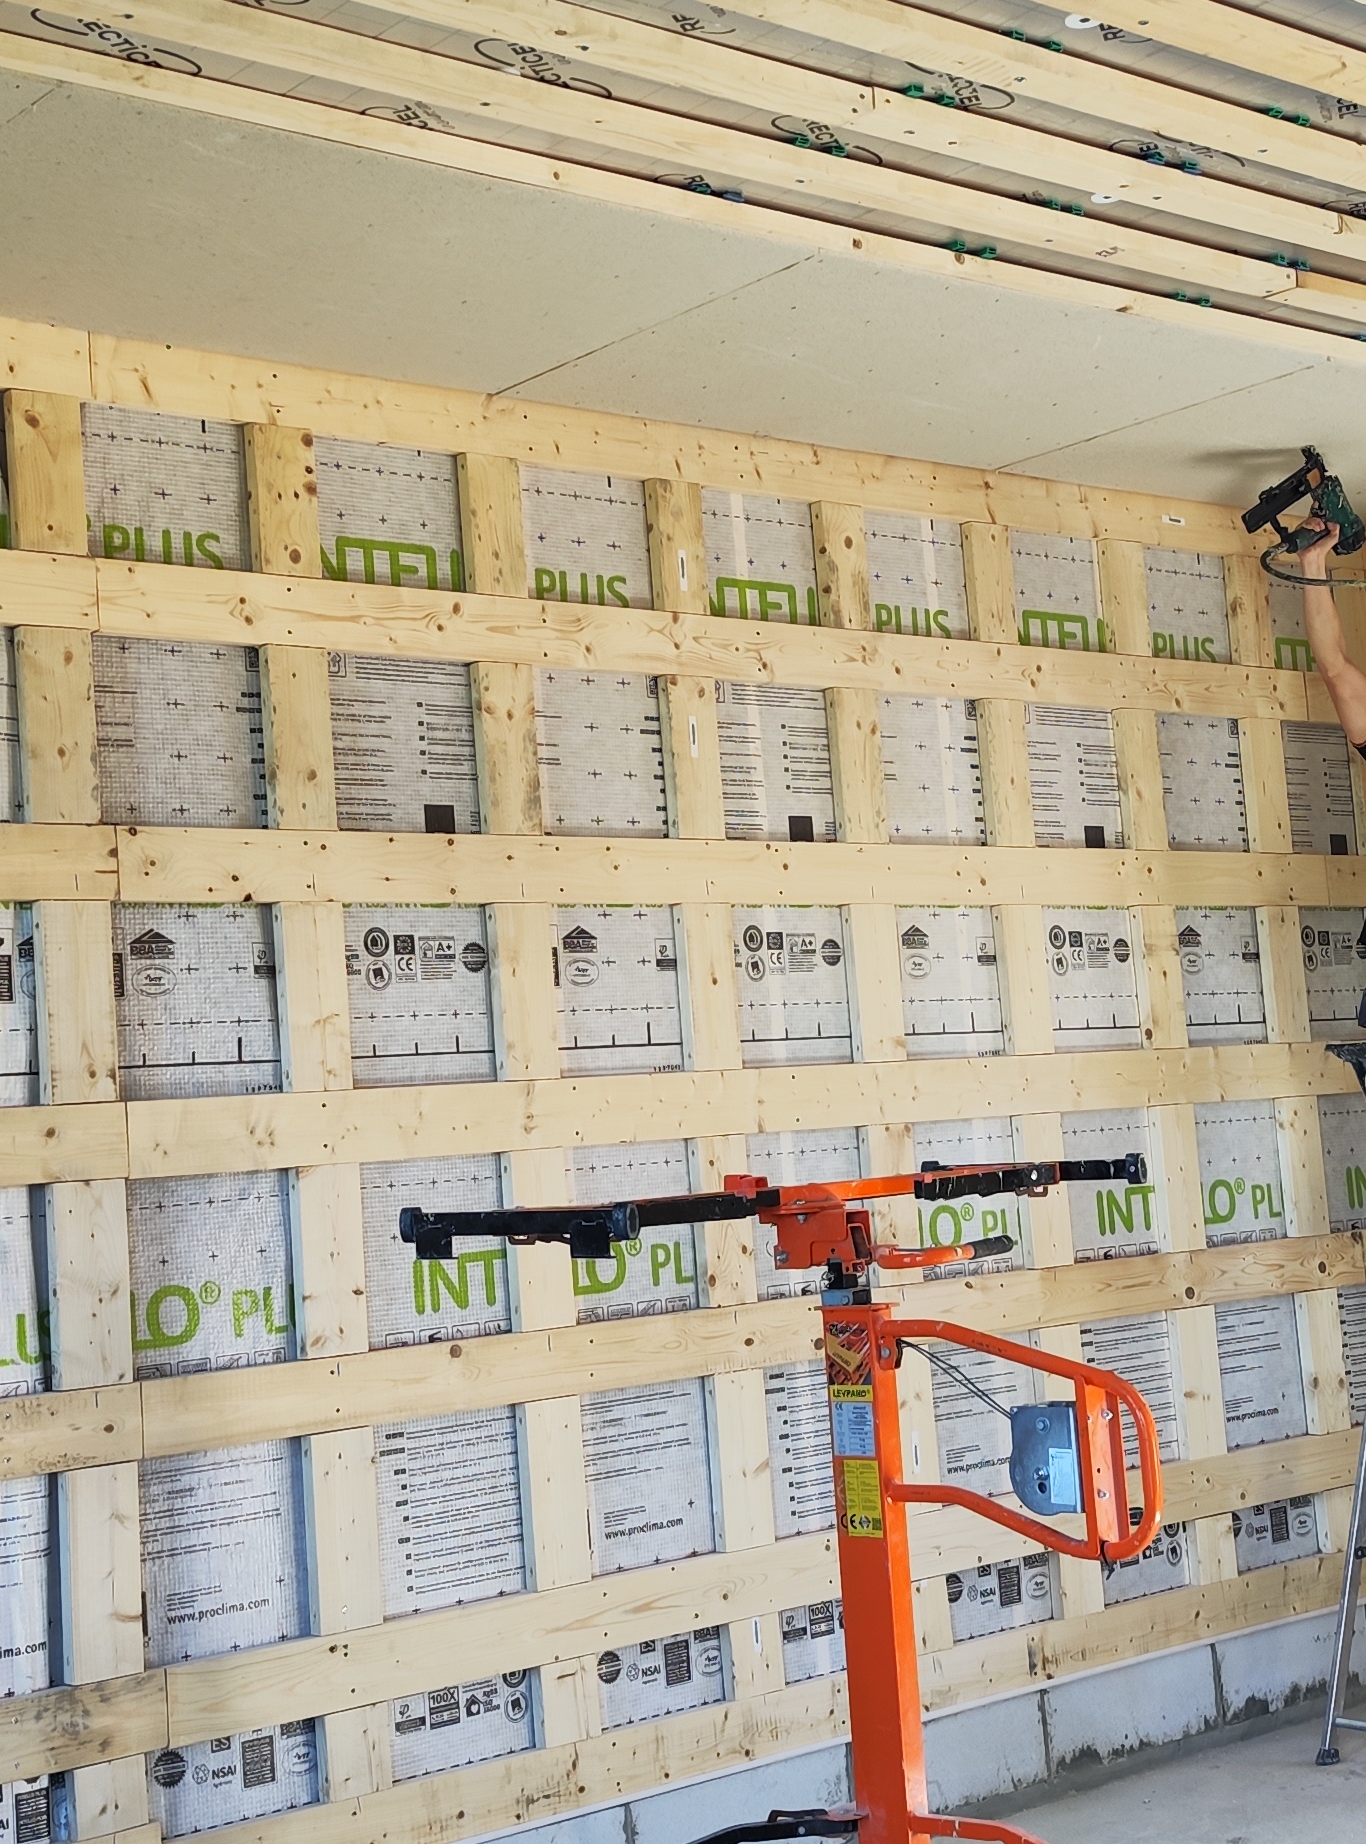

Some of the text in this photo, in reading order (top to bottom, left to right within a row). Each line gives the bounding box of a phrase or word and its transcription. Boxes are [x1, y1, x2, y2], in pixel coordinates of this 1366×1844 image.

[535, 567, 628, 608] PLUS
[875, 603, 951, 640] PLUS
[1151, 631, 1217, 663] PLUS
[436, 942, 453, 953] A+
[397, 956, 414, 971] CE
[769, 952, 783, 965] CE
[604, 1518, 684, 1541] www.proclima.com
[166, 1598, 270, 1625] www.proclima.com
[810, 1603, 832, 1617] 100X
[641, 1663, 661, 1678] NSAI
[431, 1689, 457, 1706] 100X
[211, 1765, 237, 1780] NSAI
